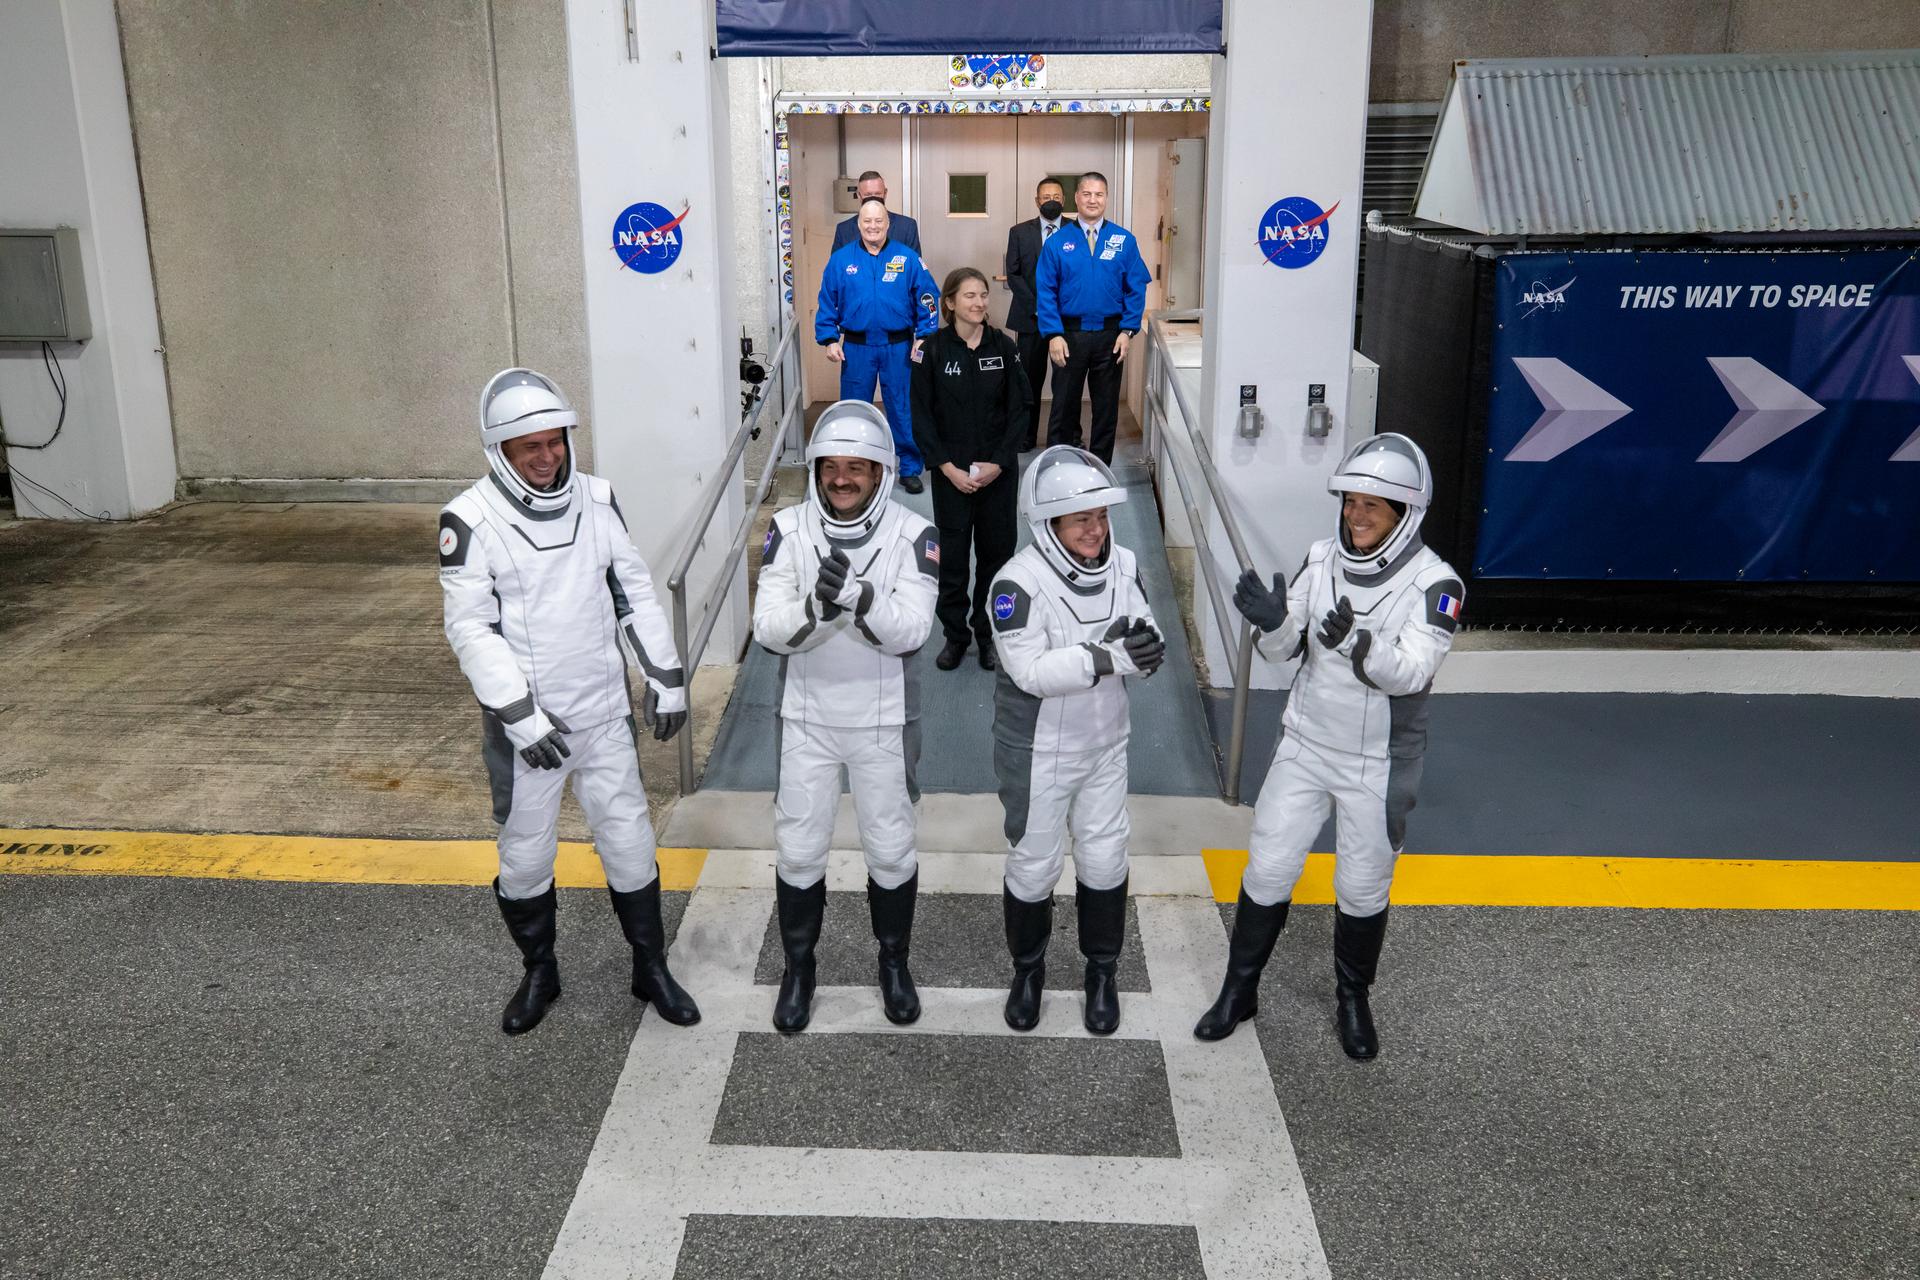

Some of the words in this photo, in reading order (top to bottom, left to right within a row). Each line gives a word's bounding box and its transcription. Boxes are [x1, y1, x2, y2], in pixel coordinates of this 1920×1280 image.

[618, 231, 679, 246] NASA
[1264, 225, 1325, 241] NASA
[1523, 292, 1565, 303] NASA
[1619, 286, 1678, 309] THIS
[1684, 285, 1743, 308] WAY
[1748, 285, 1782, 308] TO
[1787, 284, 1875, 308] SPACE
[944, 361, 962, 376] 44
[0, 842, 111, 856] KING
